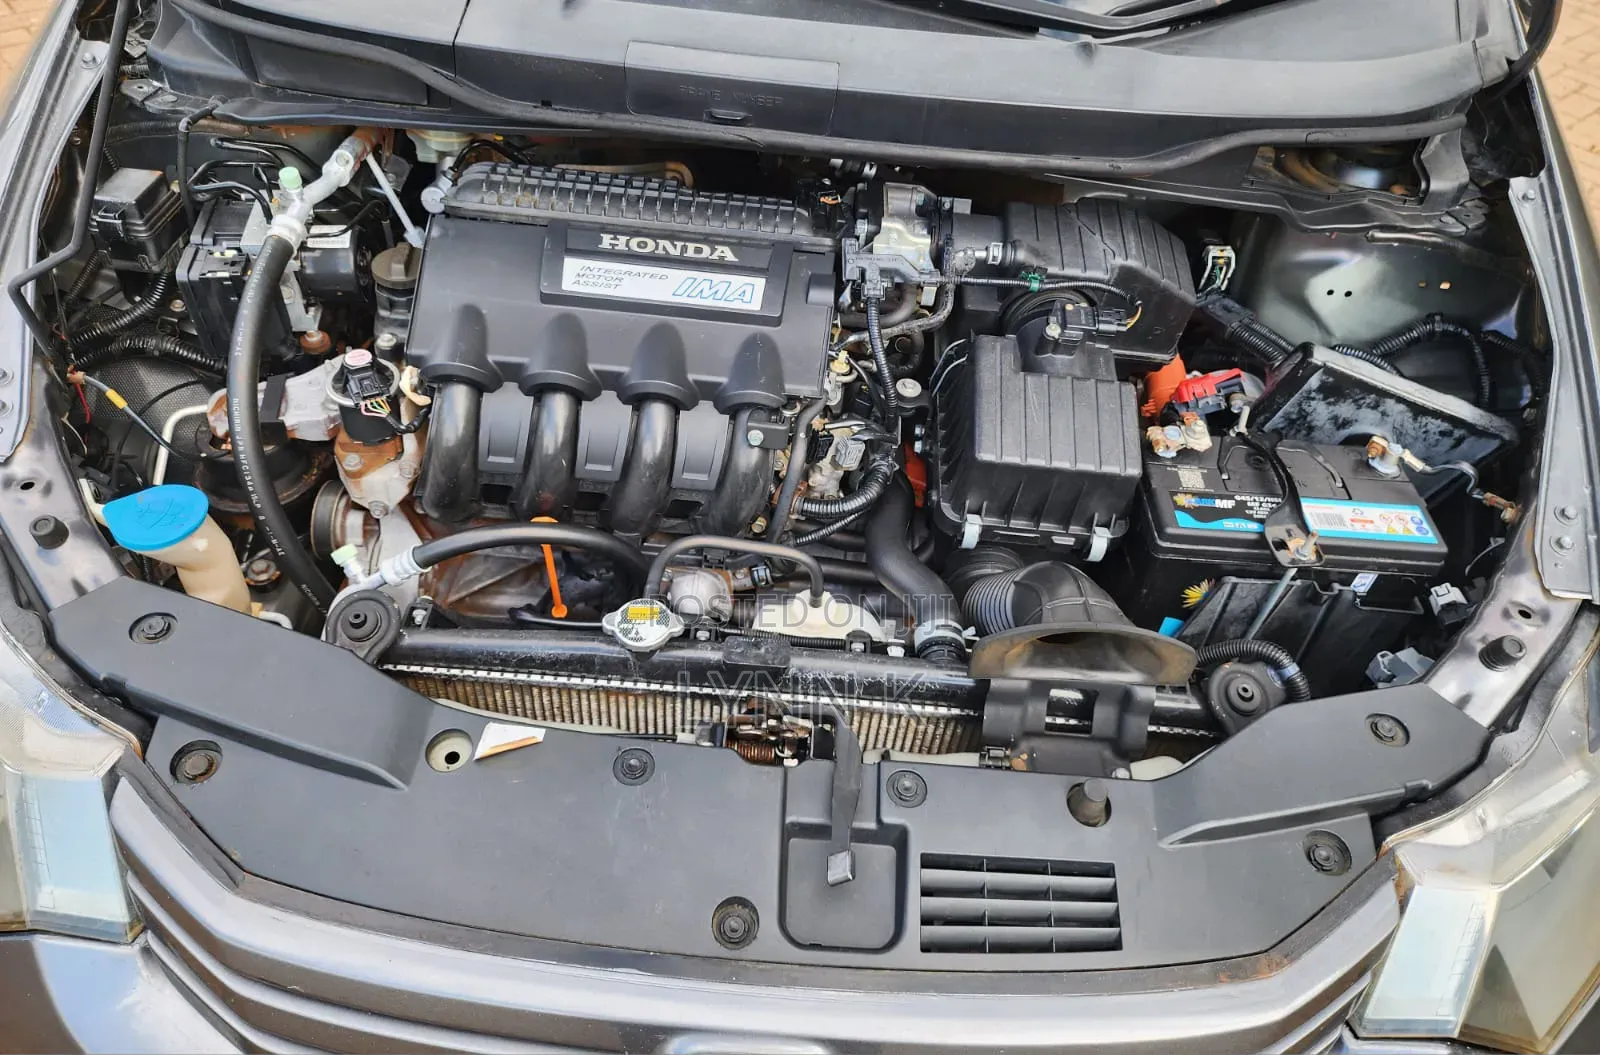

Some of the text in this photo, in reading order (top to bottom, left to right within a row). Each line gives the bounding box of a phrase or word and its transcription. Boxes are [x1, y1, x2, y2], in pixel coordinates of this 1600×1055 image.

[598, 233, 739, 262] HONDA
[575, 272, 625, 283] MOTOR
[579, 265, 669, 281] INTEGRATED
[571, 280, 623, 290] ASSIST
[672, 276, 755, 304] IMA
